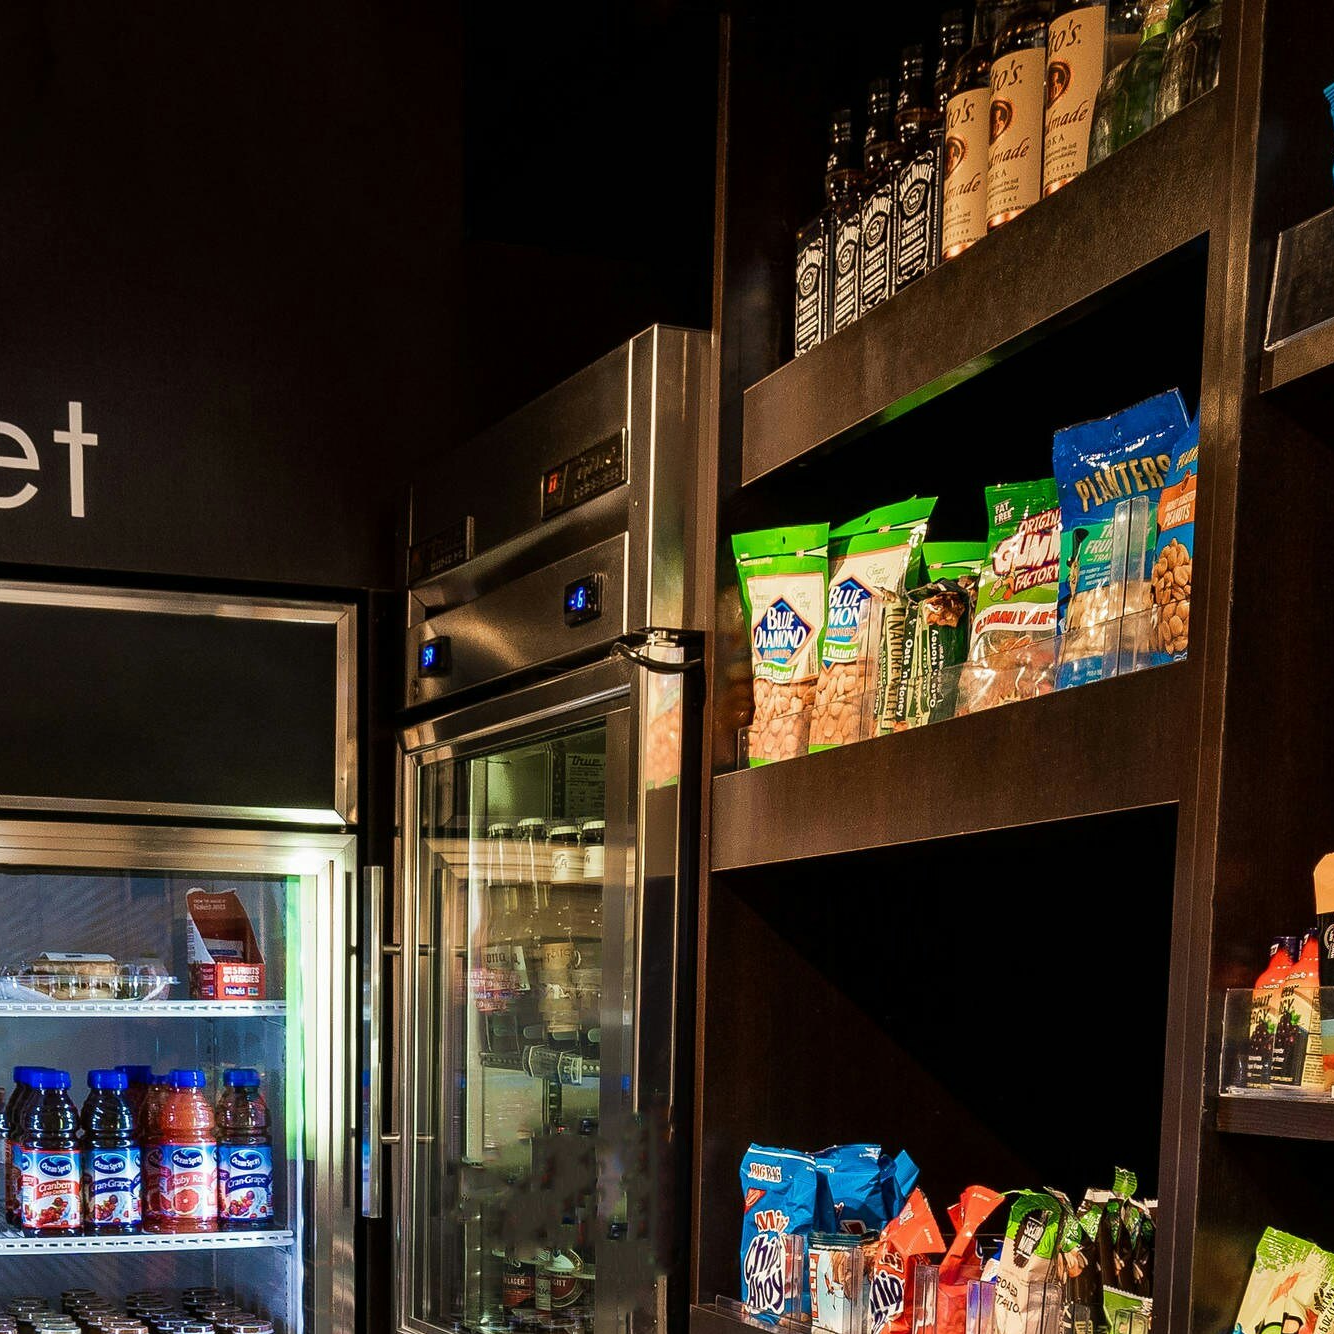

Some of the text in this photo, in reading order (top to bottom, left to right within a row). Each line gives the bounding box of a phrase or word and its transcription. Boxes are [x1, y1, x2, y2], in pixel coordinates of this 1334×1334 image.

[1074, 453, 1172, 513] PLANTERS
[994, 501, 1010, 515] FAT
[994, 508, 1013, 525] FREE
[1016, 565, 1060, 593] FACTORY
[829, 586, 863, 608] BLUE
[767, 606, 796, 630] BLUE
[755, 626, 806, 649] DIAMOND
[931, 629, 940, 667] Honey
[903, 639, 914, 666] Oats
[896, 683, 907, 718] Honey
[750, 1163, 766, 1179] BIG
[745, 1236, 786, 1281] Chips
[747, 1268, 785, 1313] Ahoy
